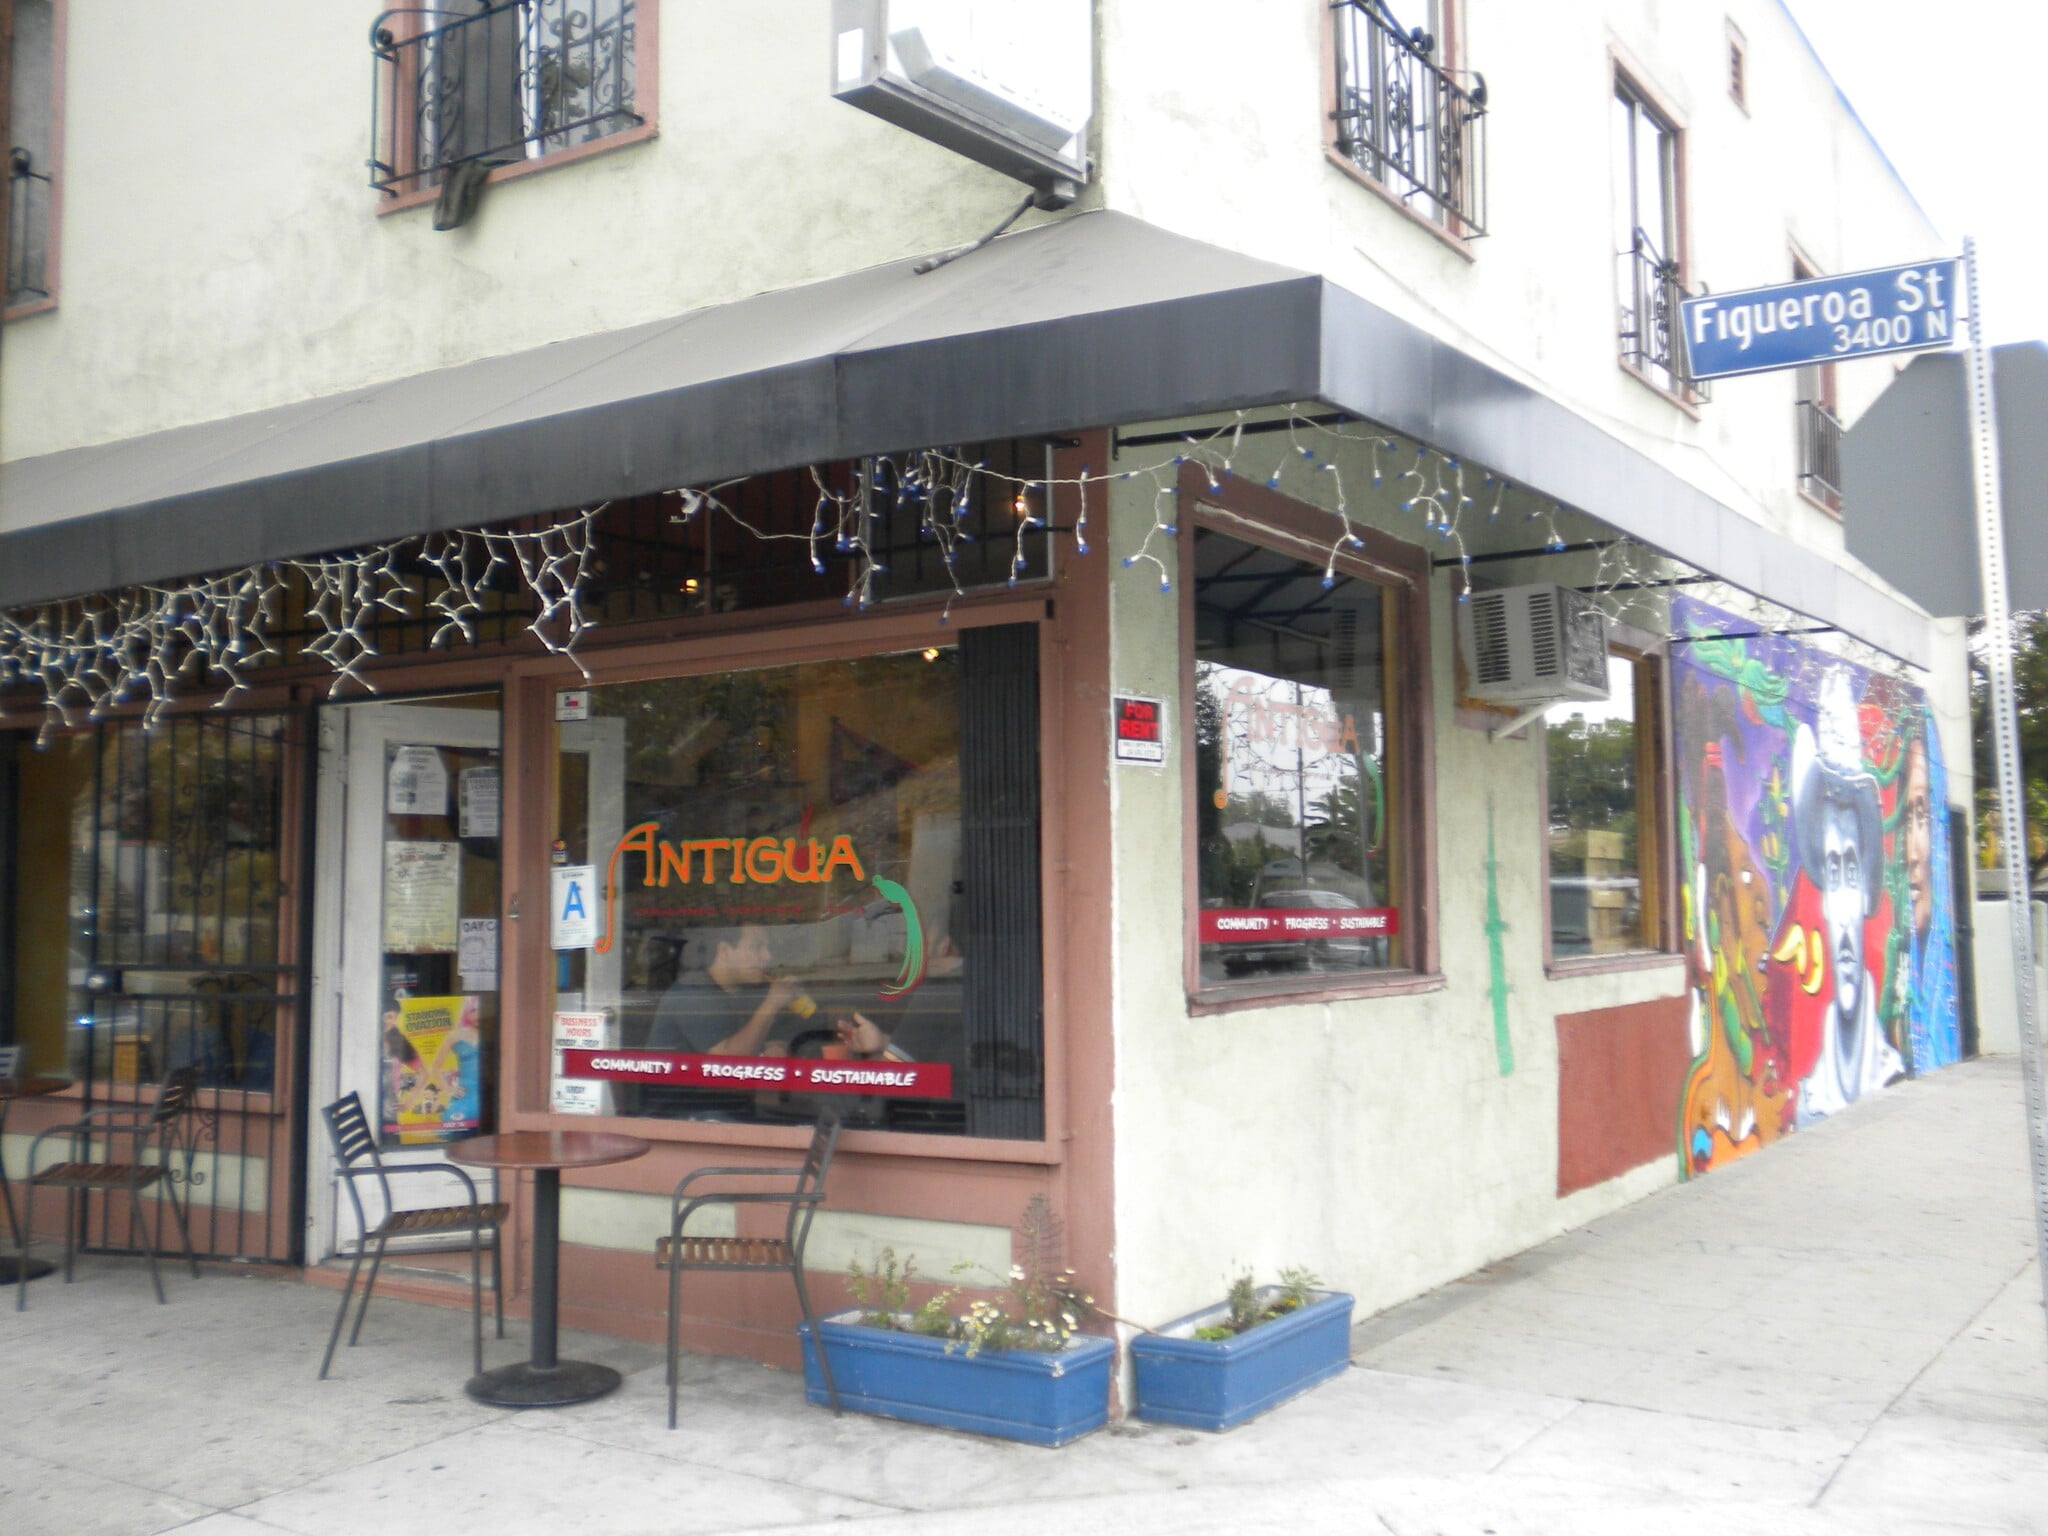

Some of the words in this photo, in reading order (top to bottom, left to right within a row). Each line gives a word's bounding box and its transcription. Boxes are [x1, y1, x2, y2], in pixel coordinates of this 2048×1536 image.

[1693, 287, 1872, 351] Figueroa
[1896, 267, 1945, 312] St
[1832, 314, 1912, 352] 3400
[1926, 309, 1948, 339] N
[1124, 701, 1155, 720] FOR
[1119, 719, 1159, 740] RENT
[594, 822, 865, 953] ANTIGUA
[561, 880, 586, 921] A
[1217, 917, 1269, 930] COMMUNITY
[1285, 917, 1330, 930] PROGRESS
[1339, 916, 1388, 929] SUSTAINABLE
[407, 1007, 451, 1021] STANDING
[560, 1016, 597, 1027] BUSINESS
[406, 1017, 452, 1033] OVATION
[566, 1027, 592, 1038] HOURS
[590, 1058, 672, 1074] COMMUNITY
[701, 1063, 785, 1081] PROGRESS
[810, 1069, 917, 1087] SUSTAINABLE
